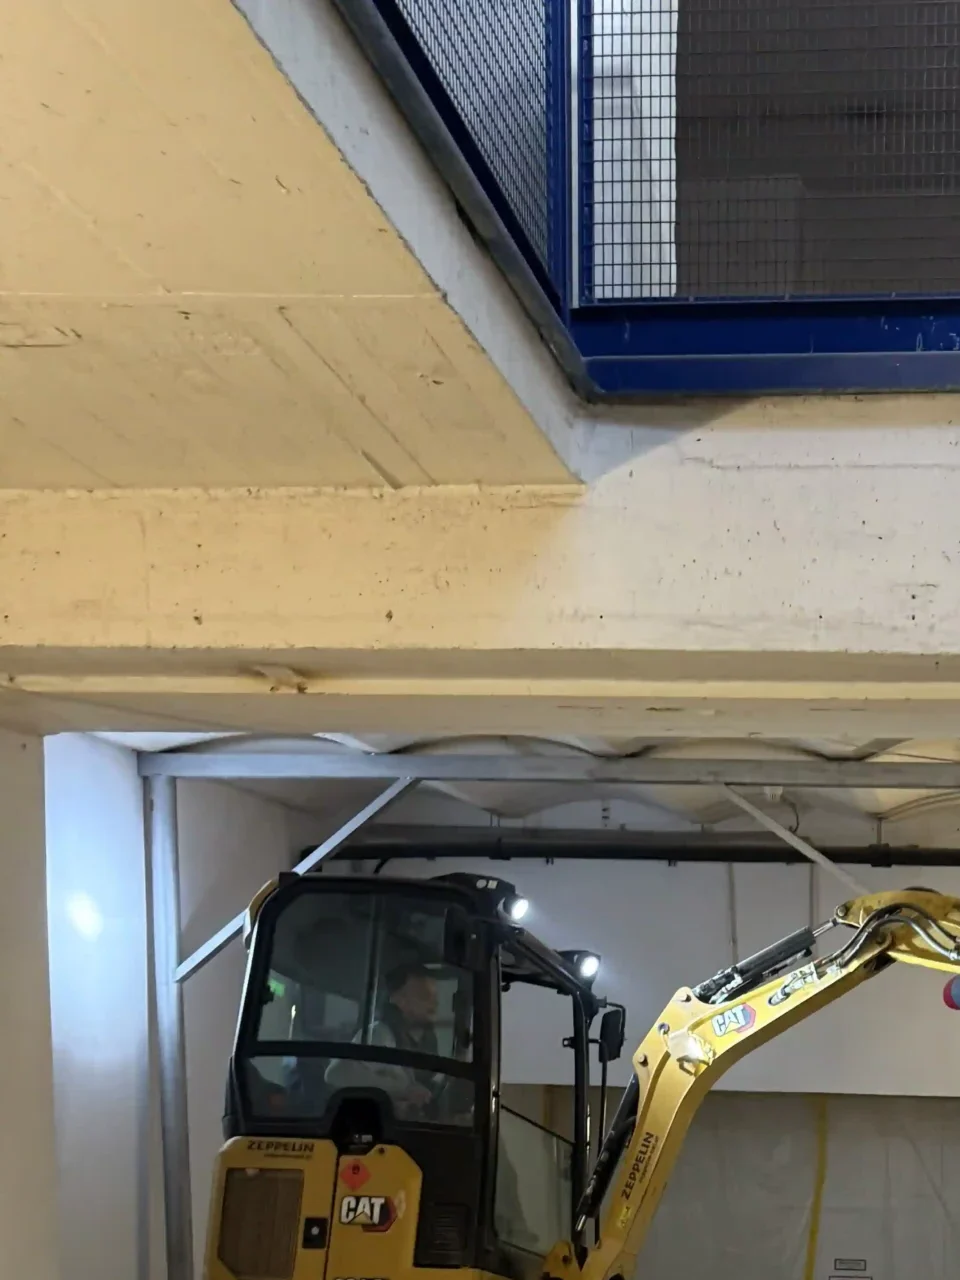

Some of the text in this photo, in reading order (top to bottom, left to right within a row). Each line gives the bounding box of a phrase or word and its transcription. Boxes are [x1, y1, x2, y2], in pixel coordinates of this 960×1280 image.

[711, 1003, 747, 1037] CAT
[247, 1139, 316, 1153] ZEPPELIN
[620, 1131, 655, 1201] ZEPPELIN
[340, 1196, 386, 1225] CAT
